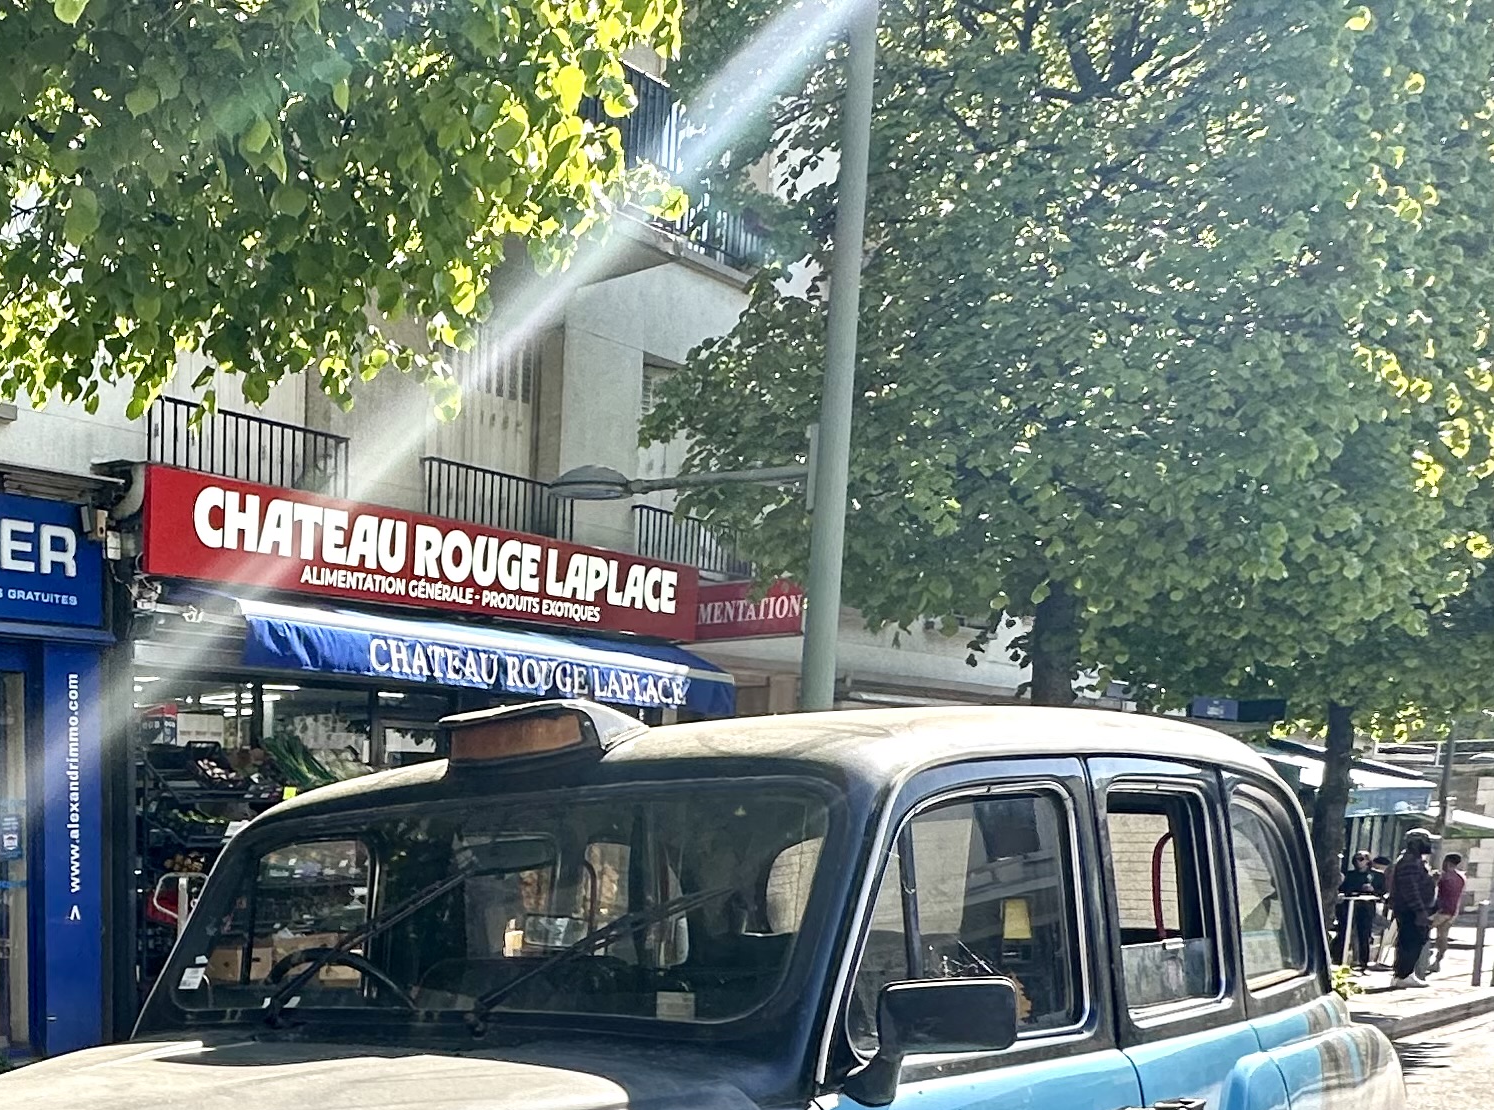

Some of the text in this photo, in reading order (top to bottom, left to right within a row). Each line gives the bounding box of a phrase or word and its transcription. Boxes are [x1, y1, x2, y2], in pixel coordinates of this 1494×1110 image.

[193, 485, 679, 615] CHATEAU ROUGE LAPLACE
[7, 588, 78, 606] GRATUITES
[300, 565, 601, 623] ALIMENTATION GÉNÉRALE PRODUITS EXOTIQUES
[370, 638, 689, 705] CHATEAU ROUGE LAPLACE
[66, 672, 81, 893] www.alexandrimmo.com
